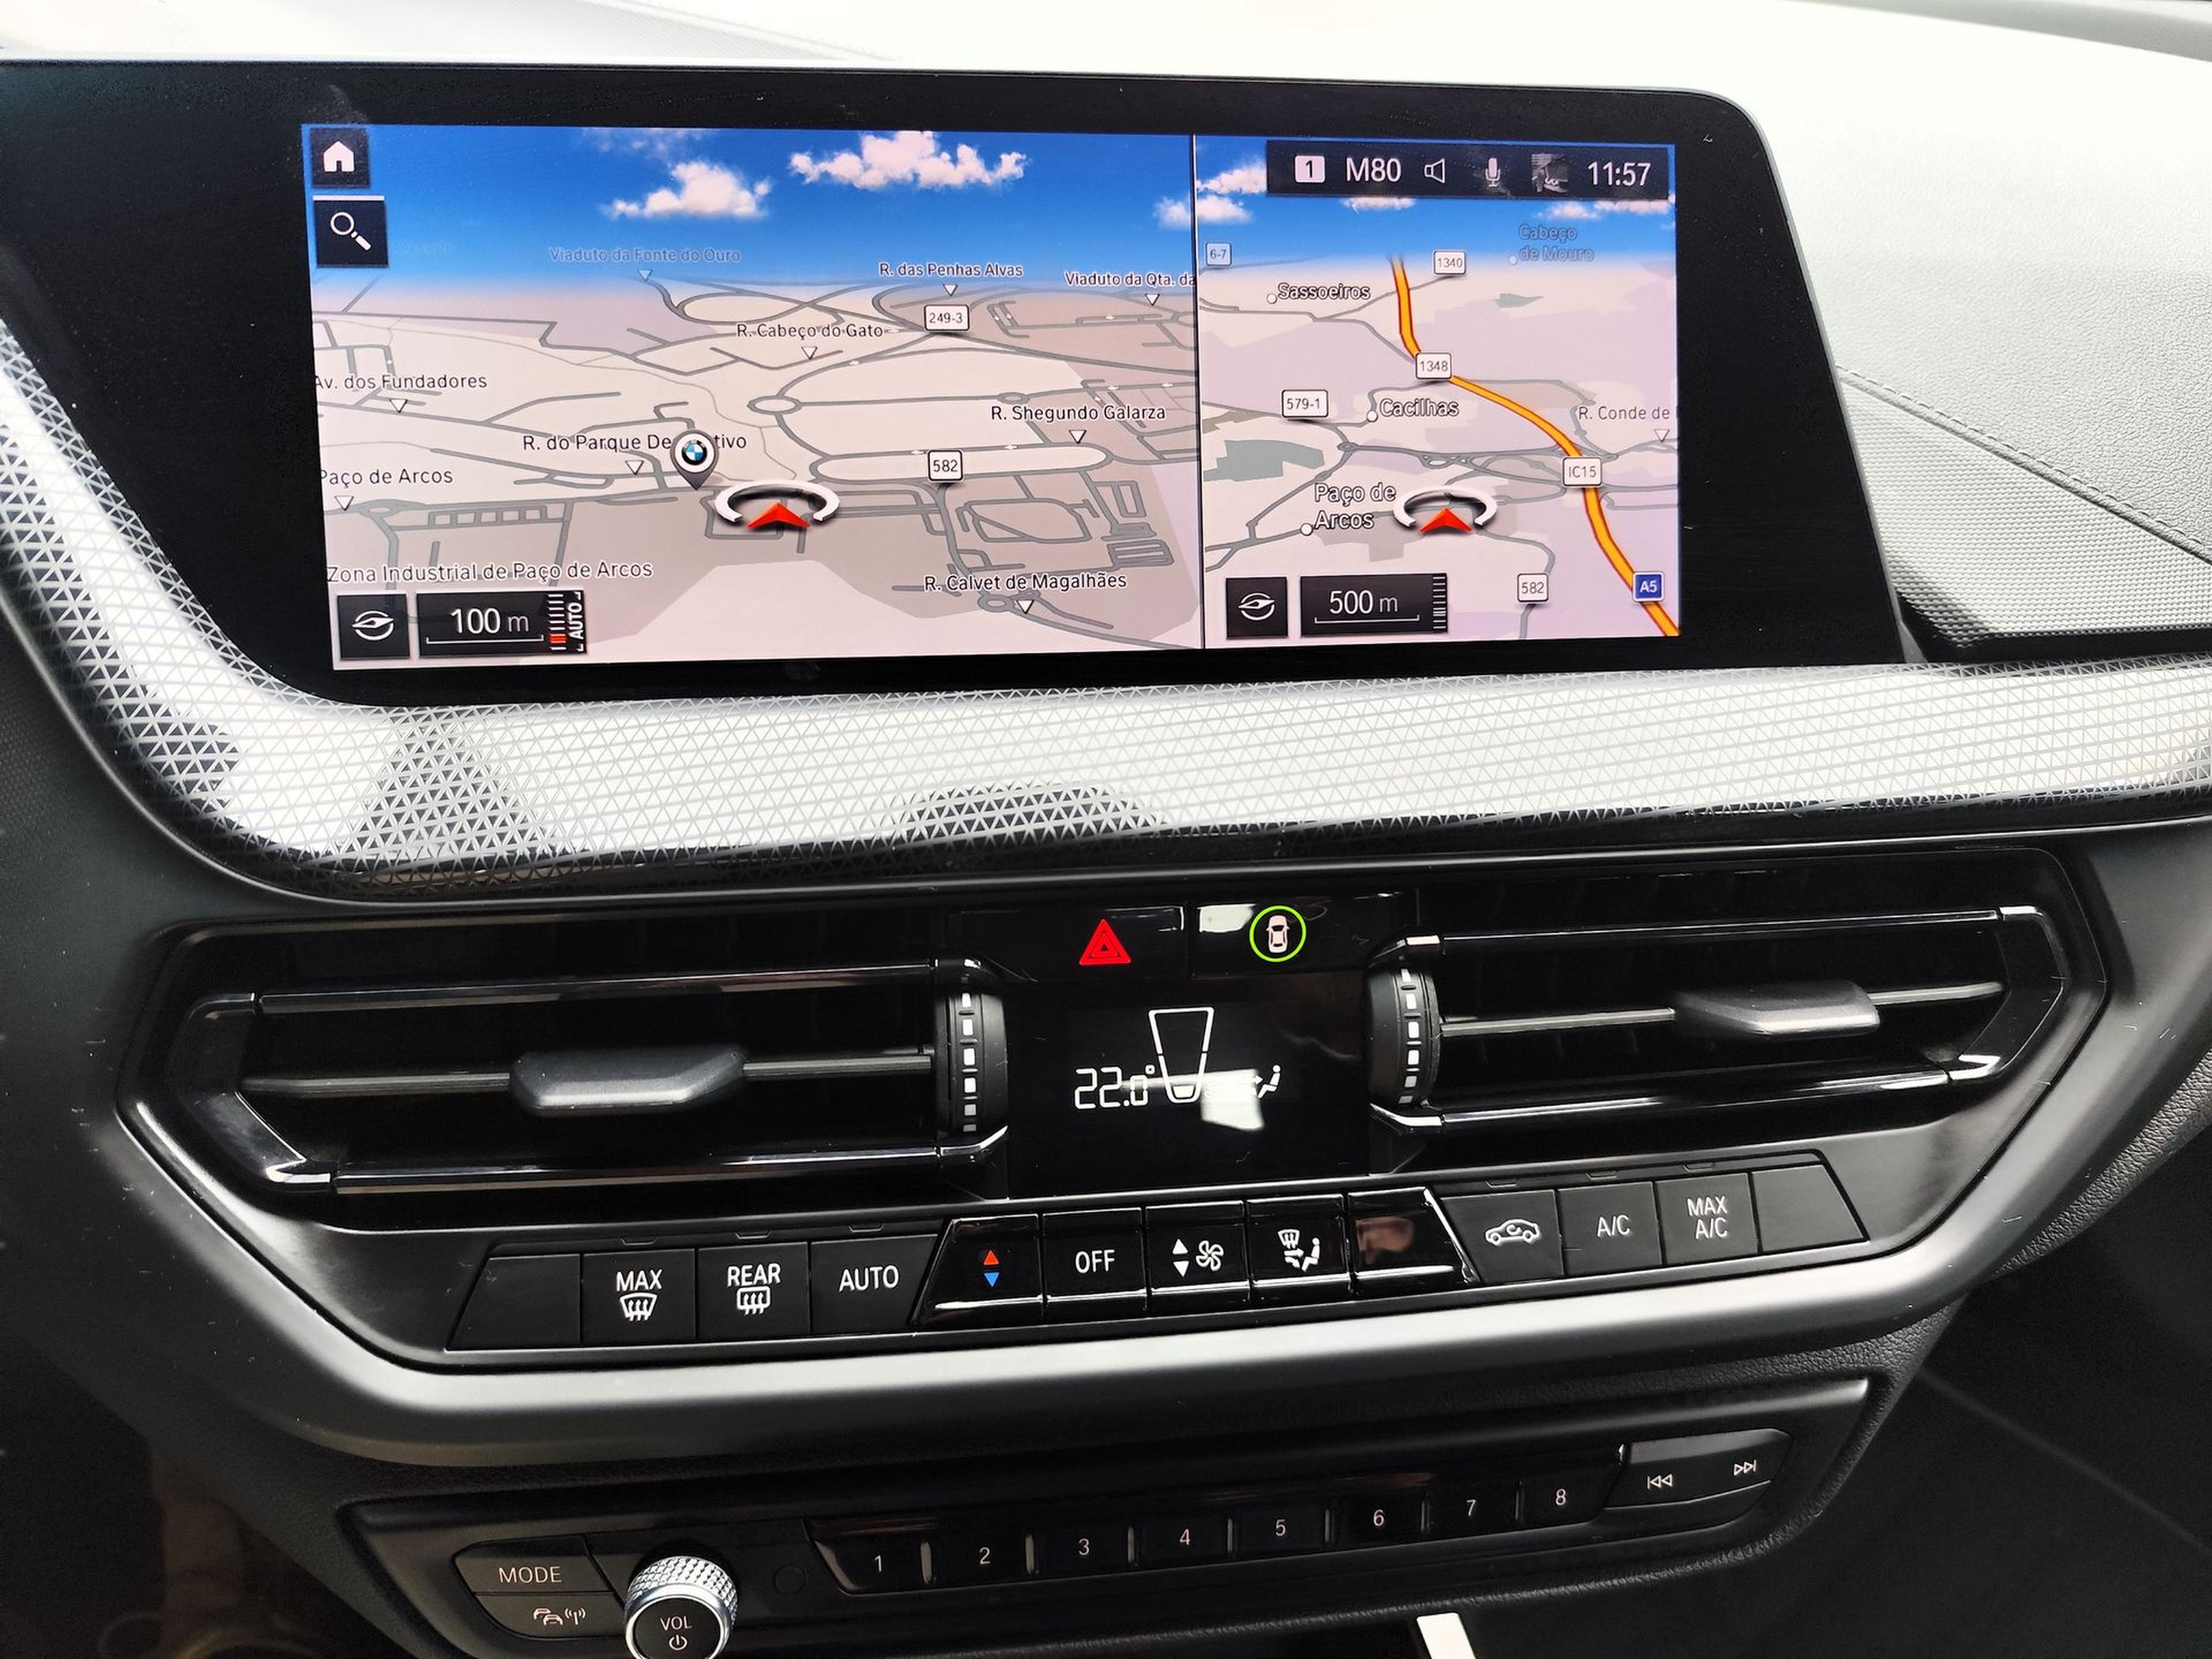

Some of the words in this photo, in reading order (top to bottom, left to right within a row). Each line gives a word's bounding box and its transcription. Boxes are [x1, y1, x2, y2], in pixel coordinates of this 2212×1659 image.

[1305, 159, 1313, 178] 1
[1346, 157, 1402, 182] M80
[1587, 162, 1652, 187] 11:57
[1518, 224, 1578, 242] Cabeço
[550, 248, 608, 261] Viaduto
[614, 248, 630, 261] da
[635, 248, 676, 261] Fonte
[681, 248, 700, 261] do
[704, 248, 740, 261] Ouro
[1210, 249, 1227, 260] 6-7
[1437, 257, 1462, 270] 1340
[1518, 247, 1540, 262] de
[1542, 247, 1594, 262] Mouro
[879, 263, 893, 276] R.
[898, 263, 923, 276] das
[927, 263, 982, 276] Penhas
[985, 263, 1023, 276] Alvas
[1065, 272, 1120, 286] Viaduto
[1124, 272, 1141, 286] da
[1147, 273, 1175, 287] Qta.
[1179, 273, 1196, 286] da
[1277, 282, 1370, 301] Sassoeiros
[929, 312, 963, 324] 249-3
[737, 323, 754, 337] R.
[759, 323, 816, 340] Cabeço
[820, 323, 841, 337] do
[846, 323, 883, 337] Gato
[1419, 361, 1449, 373] 1348
[315, 376, 338, 389] Av.
[344, 375, 376, 389] dos
[382, 374, 487, 389] Fundadores
[991, 406, 1008, 420] R.
[1012, 405, 1098, 422] Shegundo
[1103, 405, 1166, 420] Galarza
[1286, 398, 1321, 411] 579-1
[1379, 398, 1459, 417] Cacilhas
[1578, 406, 1593, 420] R.
[1598, 406, 1647, 420] Conde
[1651, 406, 1671, 420] de
[523, 435, 541, 451] R.
[546, 435, 570, 450] do
[575, 435, 641, 452] Parque
[647, 434, 747, 449] Detivo
[932, 459, 958, 474] 582
[1568, 465, 1597, 478] IC15
[369, 469, 392, 484] de
[399, 469, 453, 484] Arcos
[1313, 484, 1365, 506] Paço
[1369, 483, 1396, 502] de
[1313, 511, 1374, 530] Arcos
[327, 566, 376, 582] Zona
[383, 564, 476, 581] Industrial
[482, 564, 507, 580] de
[513, 563, 561, 582] Paço
[568, 562, 591, 578] de
[597, 561, 653, 577] Arcos
[925, 576, 942, 591] R.
[946, 575, 1002, 591] Calvet
[1006, 575, 1027, 590] de
[1032, 573, 1127, 591] Magalhães
[1521, 582, 1545, 595] 582
[1639, 580, 1657, 594] A5
[1329, 590, 1374, 614] 500
[1379, 597, 1398, 612] m
[450, 608, 500, 634] 100
[508, 614, 529, 631] m
[569, 602, 583, 640] AUTO
[1687, 1196, 1727, 1217] MAX
[1597, 1215, 1631, 1237] A/C
[1695, 1217, 1728, 1240] A/C
[1075, 1249, 1115, 1274] OFF
[616, 1269, 663, 1291] MAX
[727, 1263, 781, 1287] REAR
[839, 1265, 899, 1293] AUTO
[1555, 1488, 1567, 1505] 8
[1373, 1509, 1385, 1526] 6
[1465, 1499, 1476, 1518] 7
[1179, 1528, 1191, 1545] 4
[1275, 1519, 1286, 1536] 5
[979, 1547, 991, 1565] 2
[1078, 1538, 1090, 1556] 3
[874, 1555, 883, 1572] 1
[498, 1565, 563, 1584] MODE
[660, 1616, 692, 1631] VOL
